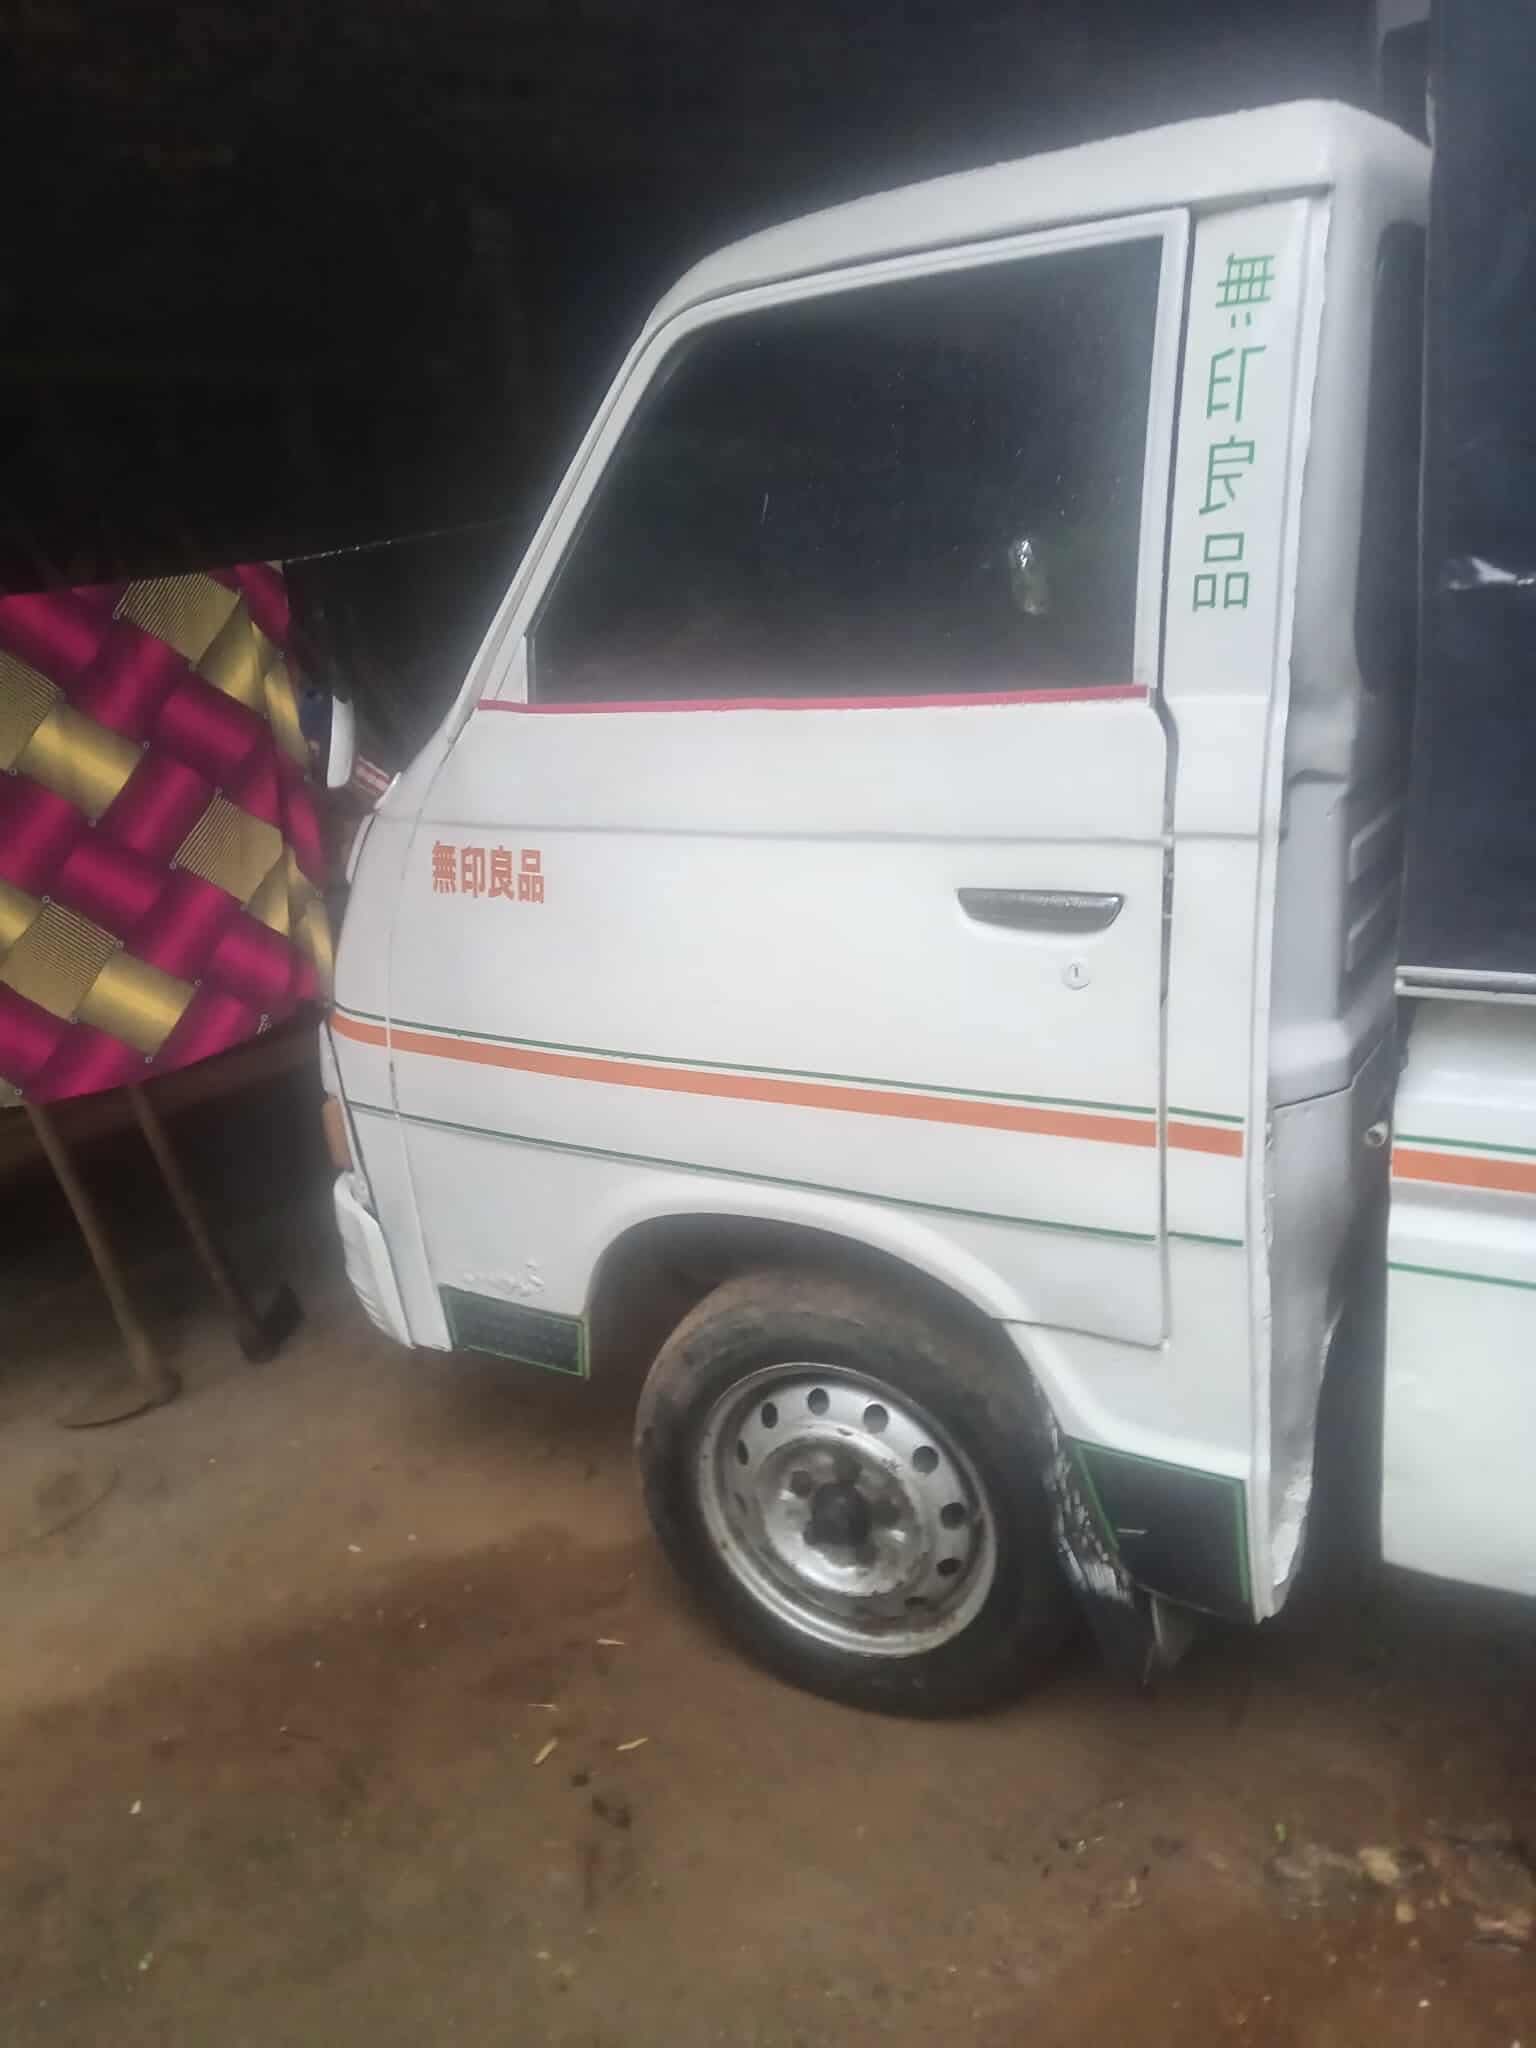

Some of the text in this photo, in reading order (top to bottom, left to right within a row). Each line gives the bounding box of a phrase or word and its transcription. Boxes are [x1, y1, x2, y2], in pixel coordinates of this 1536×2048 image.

[1193, 253, 1275, 612] 無印良品
[432, 840, 544, 904] 無印良品
